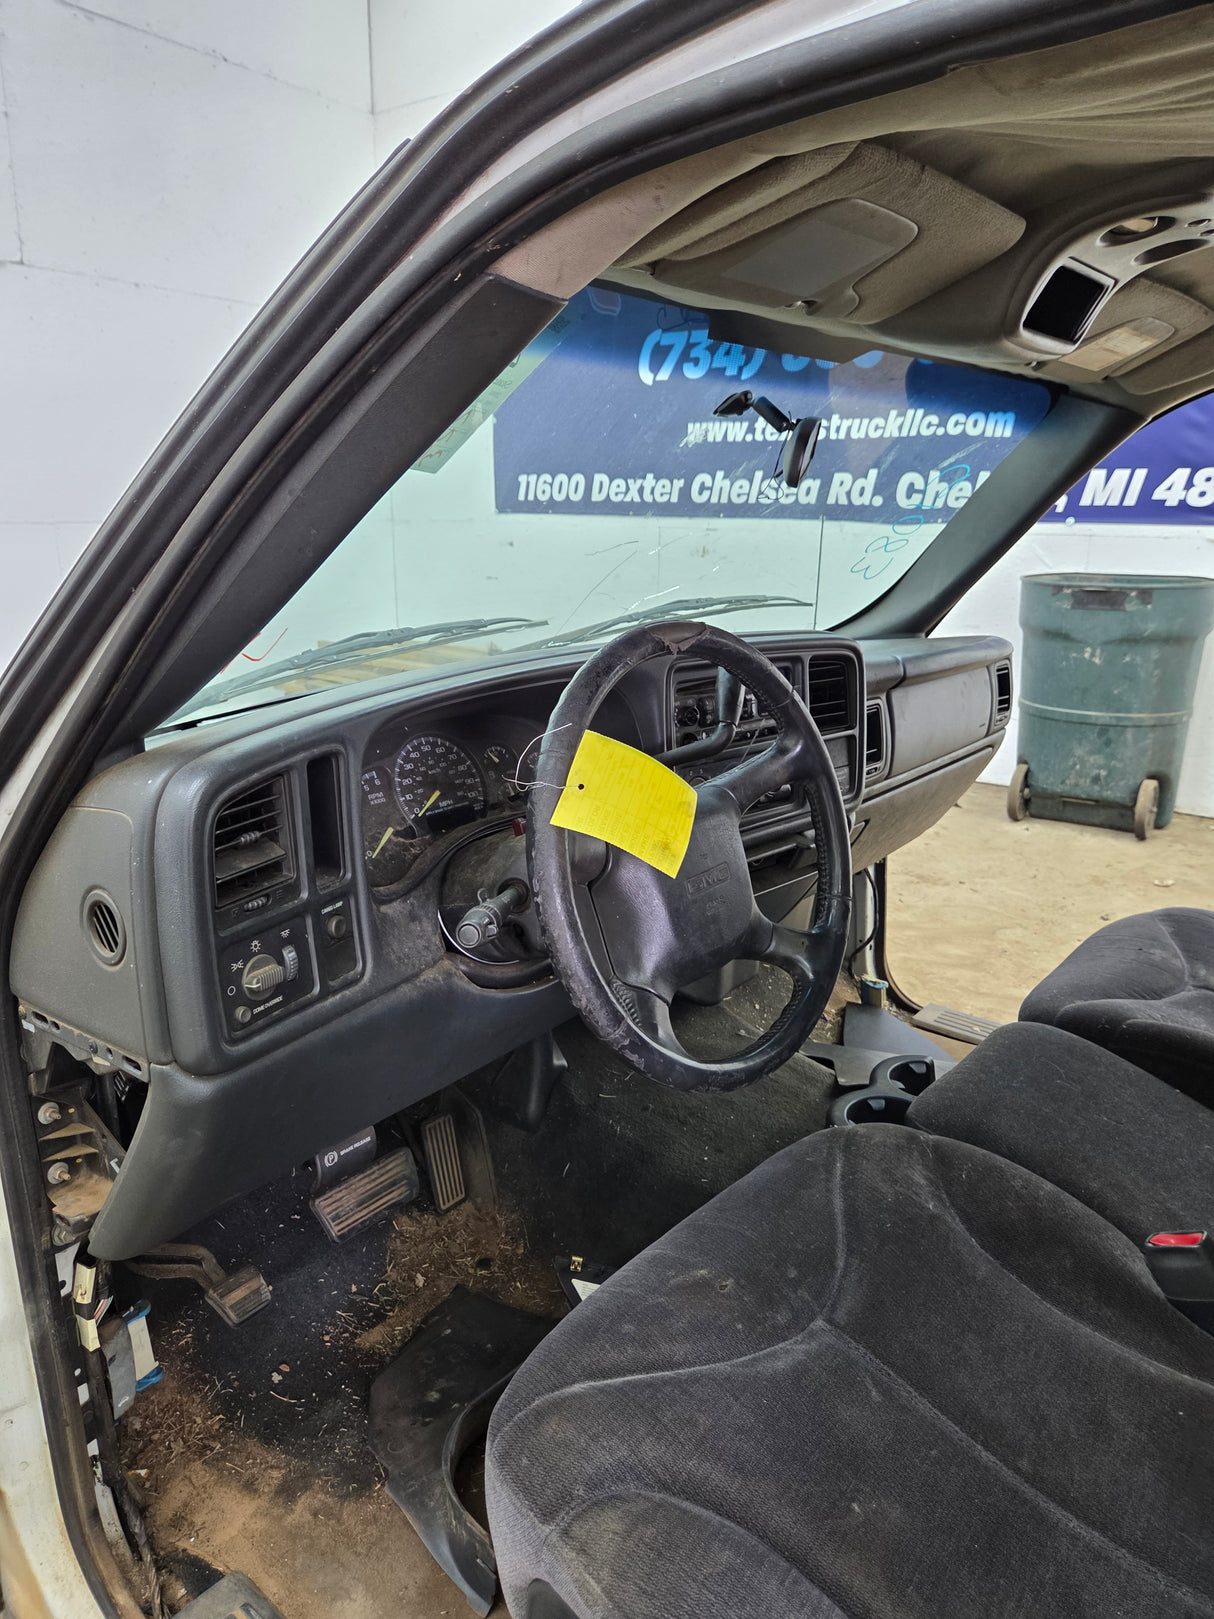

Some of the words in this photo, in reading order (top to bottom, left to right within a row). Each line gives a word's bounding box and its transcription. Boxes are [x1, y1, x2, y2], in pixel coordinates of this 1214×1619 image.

[638, 328, 767, 386] (734)
[517, 472, 585, 502] 11600
[591, 471, 685, 503] Dexter
[691, 470, 821, 505] Chelsea
[826, 468, 883, 507] Rd.
[1079, 468, 1148, 506] MI
[368, 792, 384, 800] RPM
[439, 799, 453, 807] MPH
